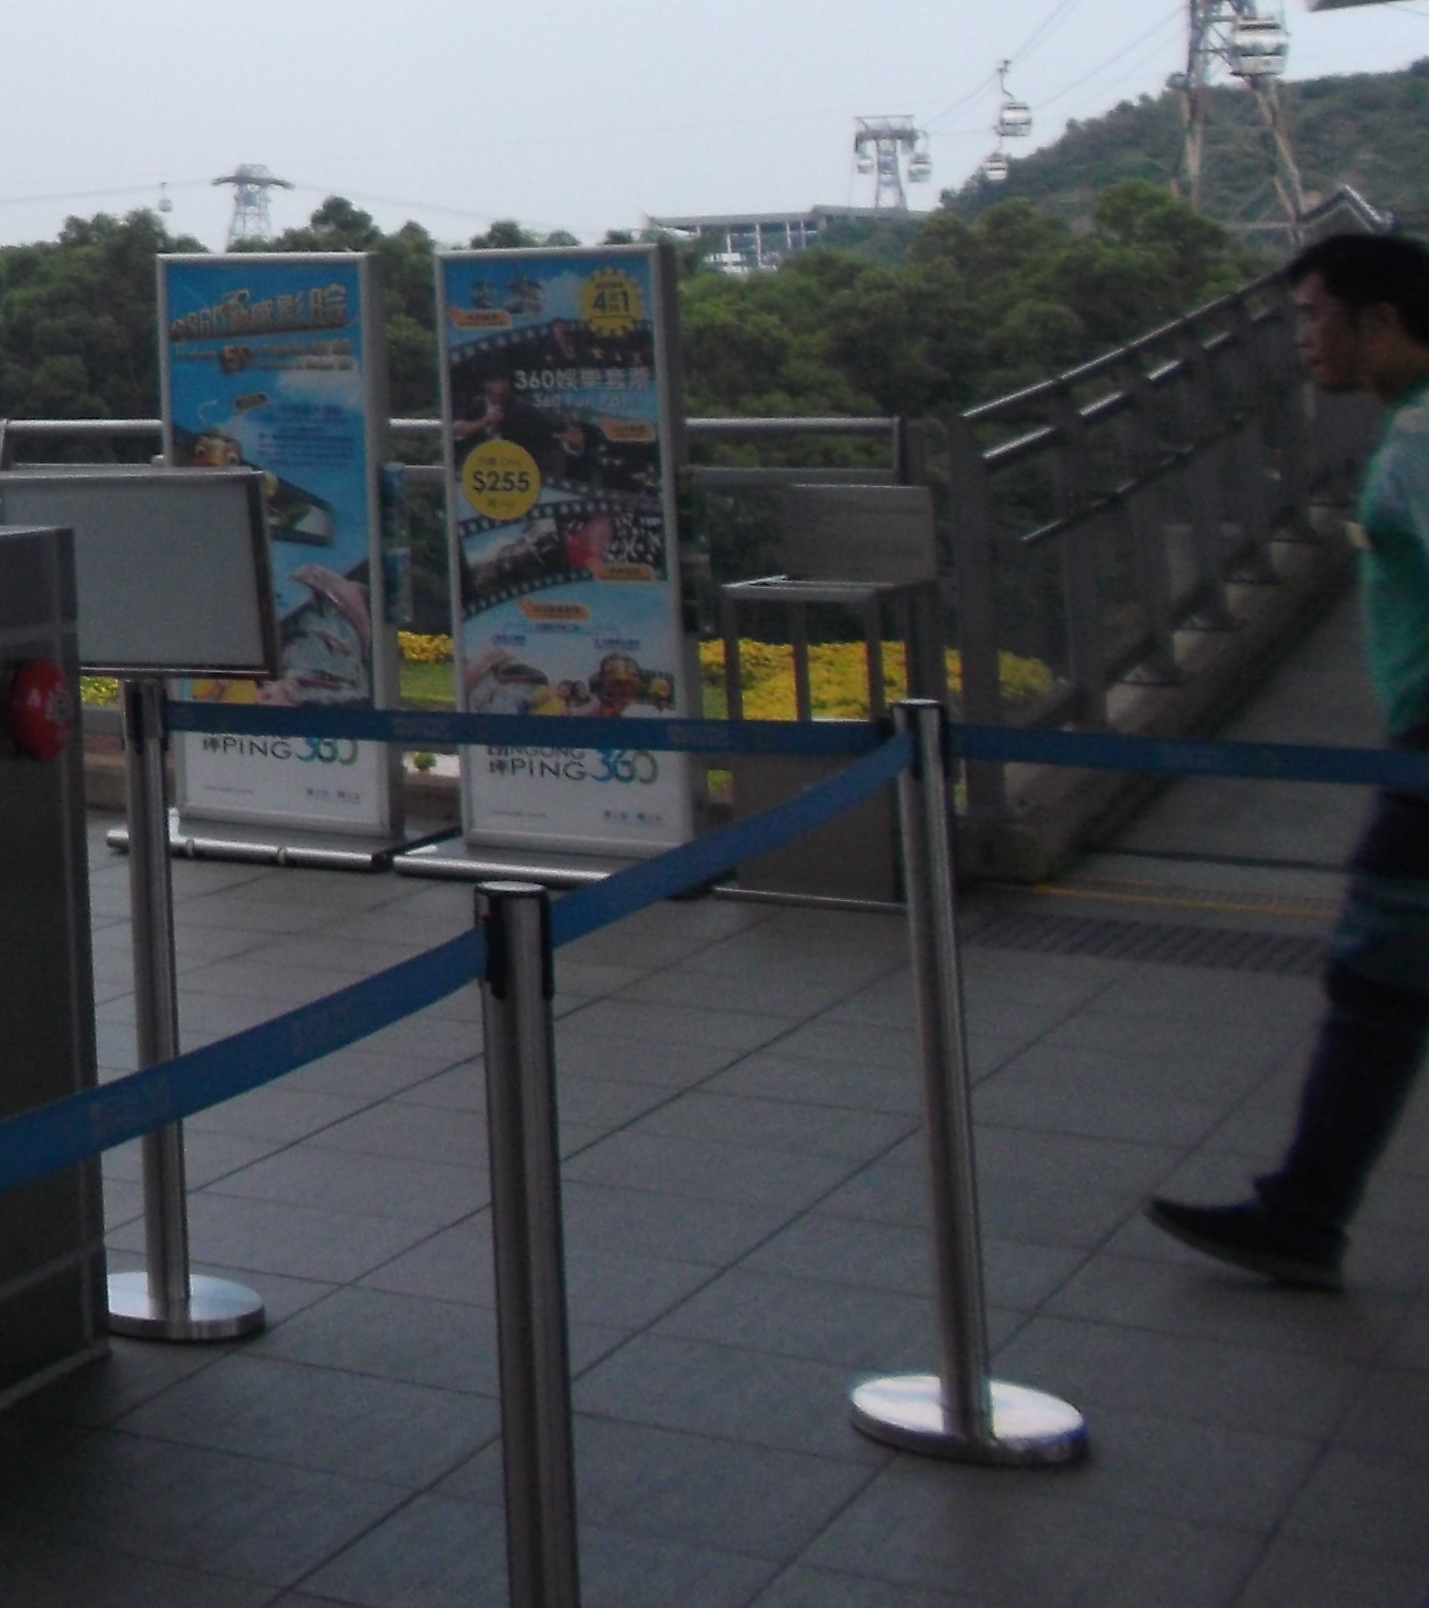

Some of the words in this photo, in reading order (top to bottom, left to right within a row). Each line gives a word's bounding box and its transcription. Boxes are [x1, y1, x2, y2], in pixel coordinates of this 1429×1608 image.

[533, 393, 561, 409] 360
[472, 470, 530, 494] $255
[222, 736, 292, 760] PING
[510, 757, 587, 781] PING
[588, 748, 659, 785] 360
